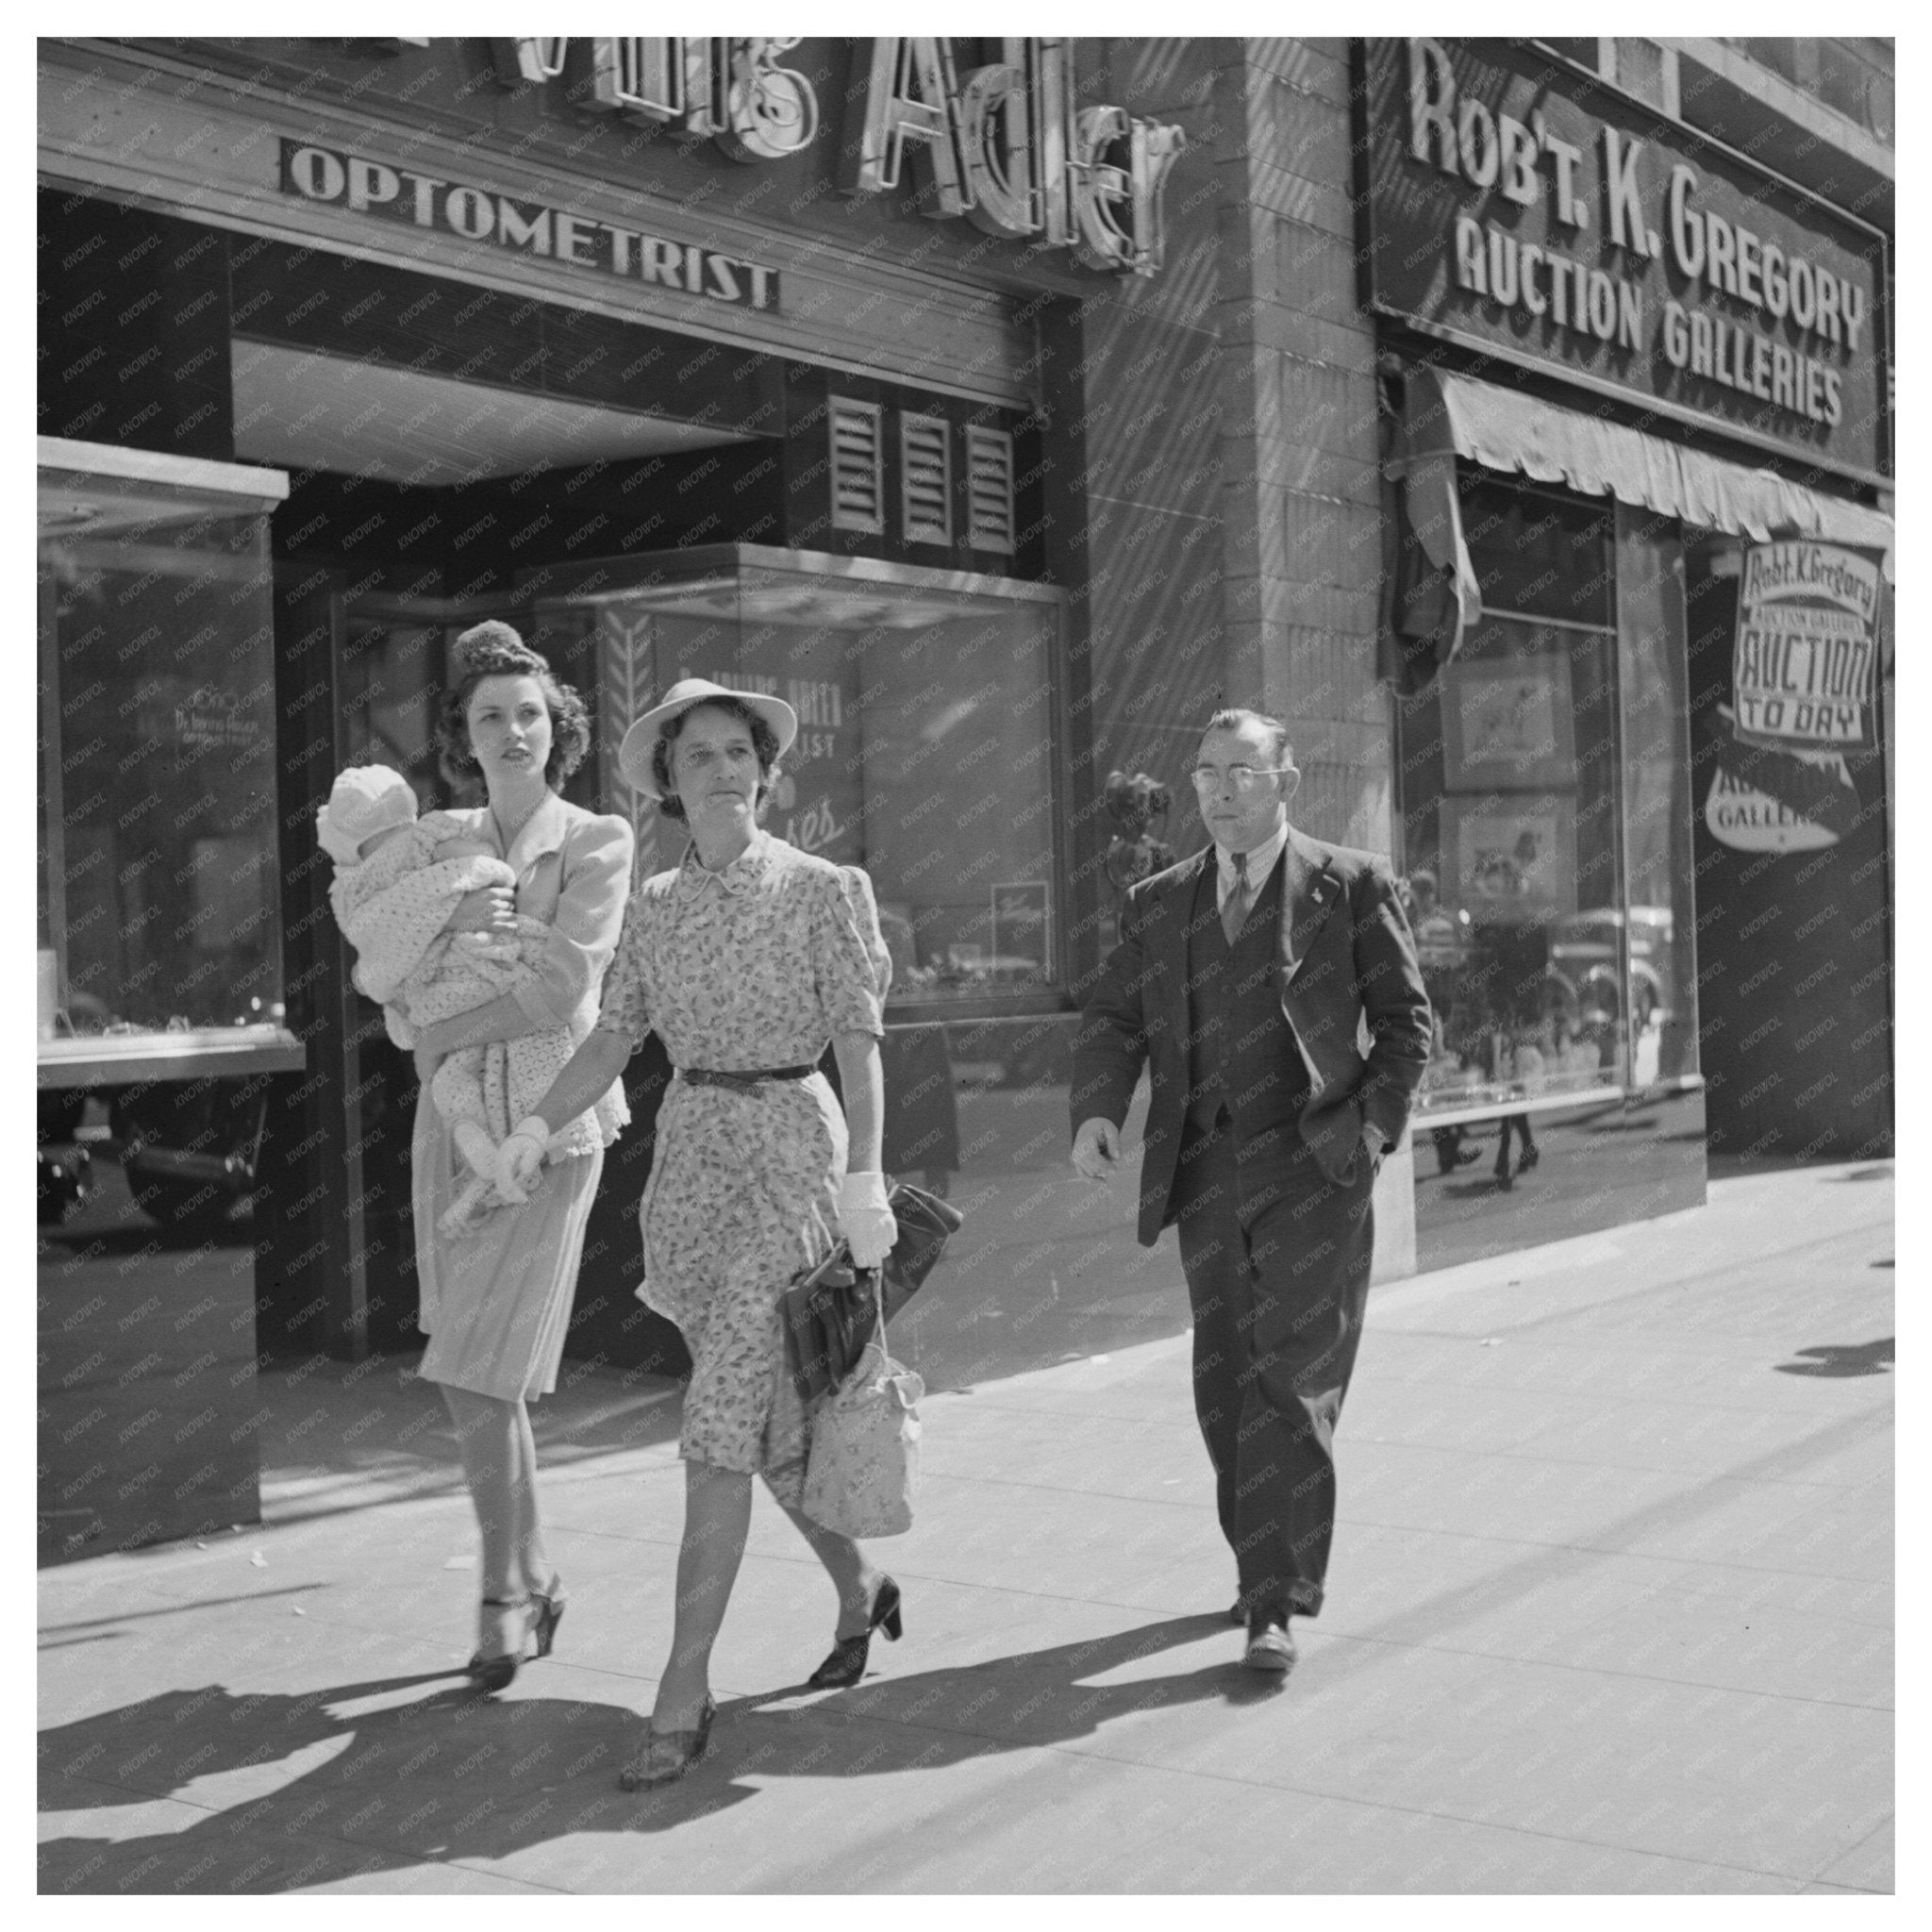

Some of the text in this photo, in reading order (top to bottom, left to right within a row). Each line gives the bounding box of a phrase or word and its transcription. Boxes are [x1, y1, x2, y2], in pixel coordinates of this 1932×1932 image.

[291, 147, 779, 304] OPTOMETRIST
[1671, 164, 1864, 353] GREGORY
[1456, 215, 1842, 426] AUCTION GALLERIES
[1742, 630, 1875, 697] AUCTION
